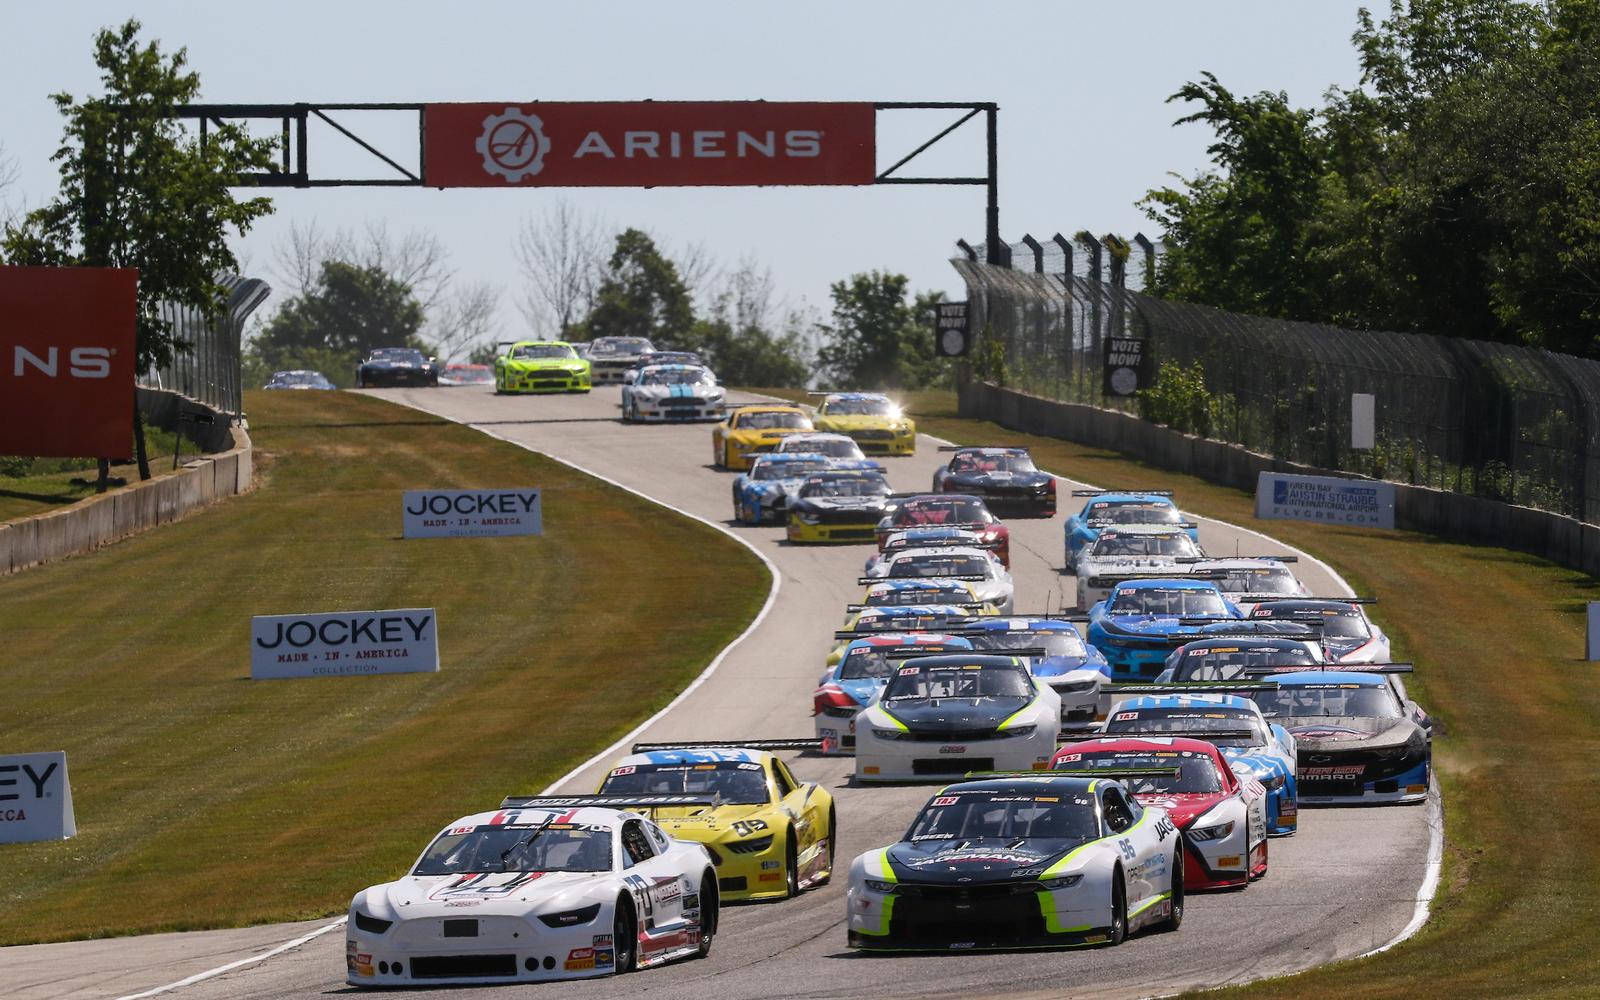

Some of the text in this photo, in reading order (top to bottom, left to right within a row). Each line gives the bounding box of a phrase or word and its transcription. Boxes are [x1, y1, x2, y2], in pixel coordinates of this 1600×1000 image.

[572, 130, 821, 159] ARIENS
[940, 305, 966, 316] VOTE
[939, 317, 967, 328] NOW!
[1111, 341, 1141, 353] VOTE
[1108, 354, 1141, 366] NOW!
[1289, 482, 1316, 491] GREEN
[1290, 489, 1378, 507] AUSTIN STRAUBEL
[407, 493, 537, 516] JOCKEY
[1289, 499, 1380, 513] INTERNATIONAL AIRPORT
[423, 517, 521, 527] MADE IN AMERICA
[256, 616, 431, 649] JOCKEY
[277, 649, 409, 663] MADE IN AMERICA
[312, 665, 378, 674] COLLECTION
[1059, 754, 1081, 763] TA2
[614, 767, 635, 775] TA2
[581, 797, 637, 805] RACE
[935, 797, 957, 806] TA2
[451, 827, 474, 835] TA2
[1119, 838, 1137, 860] 96
